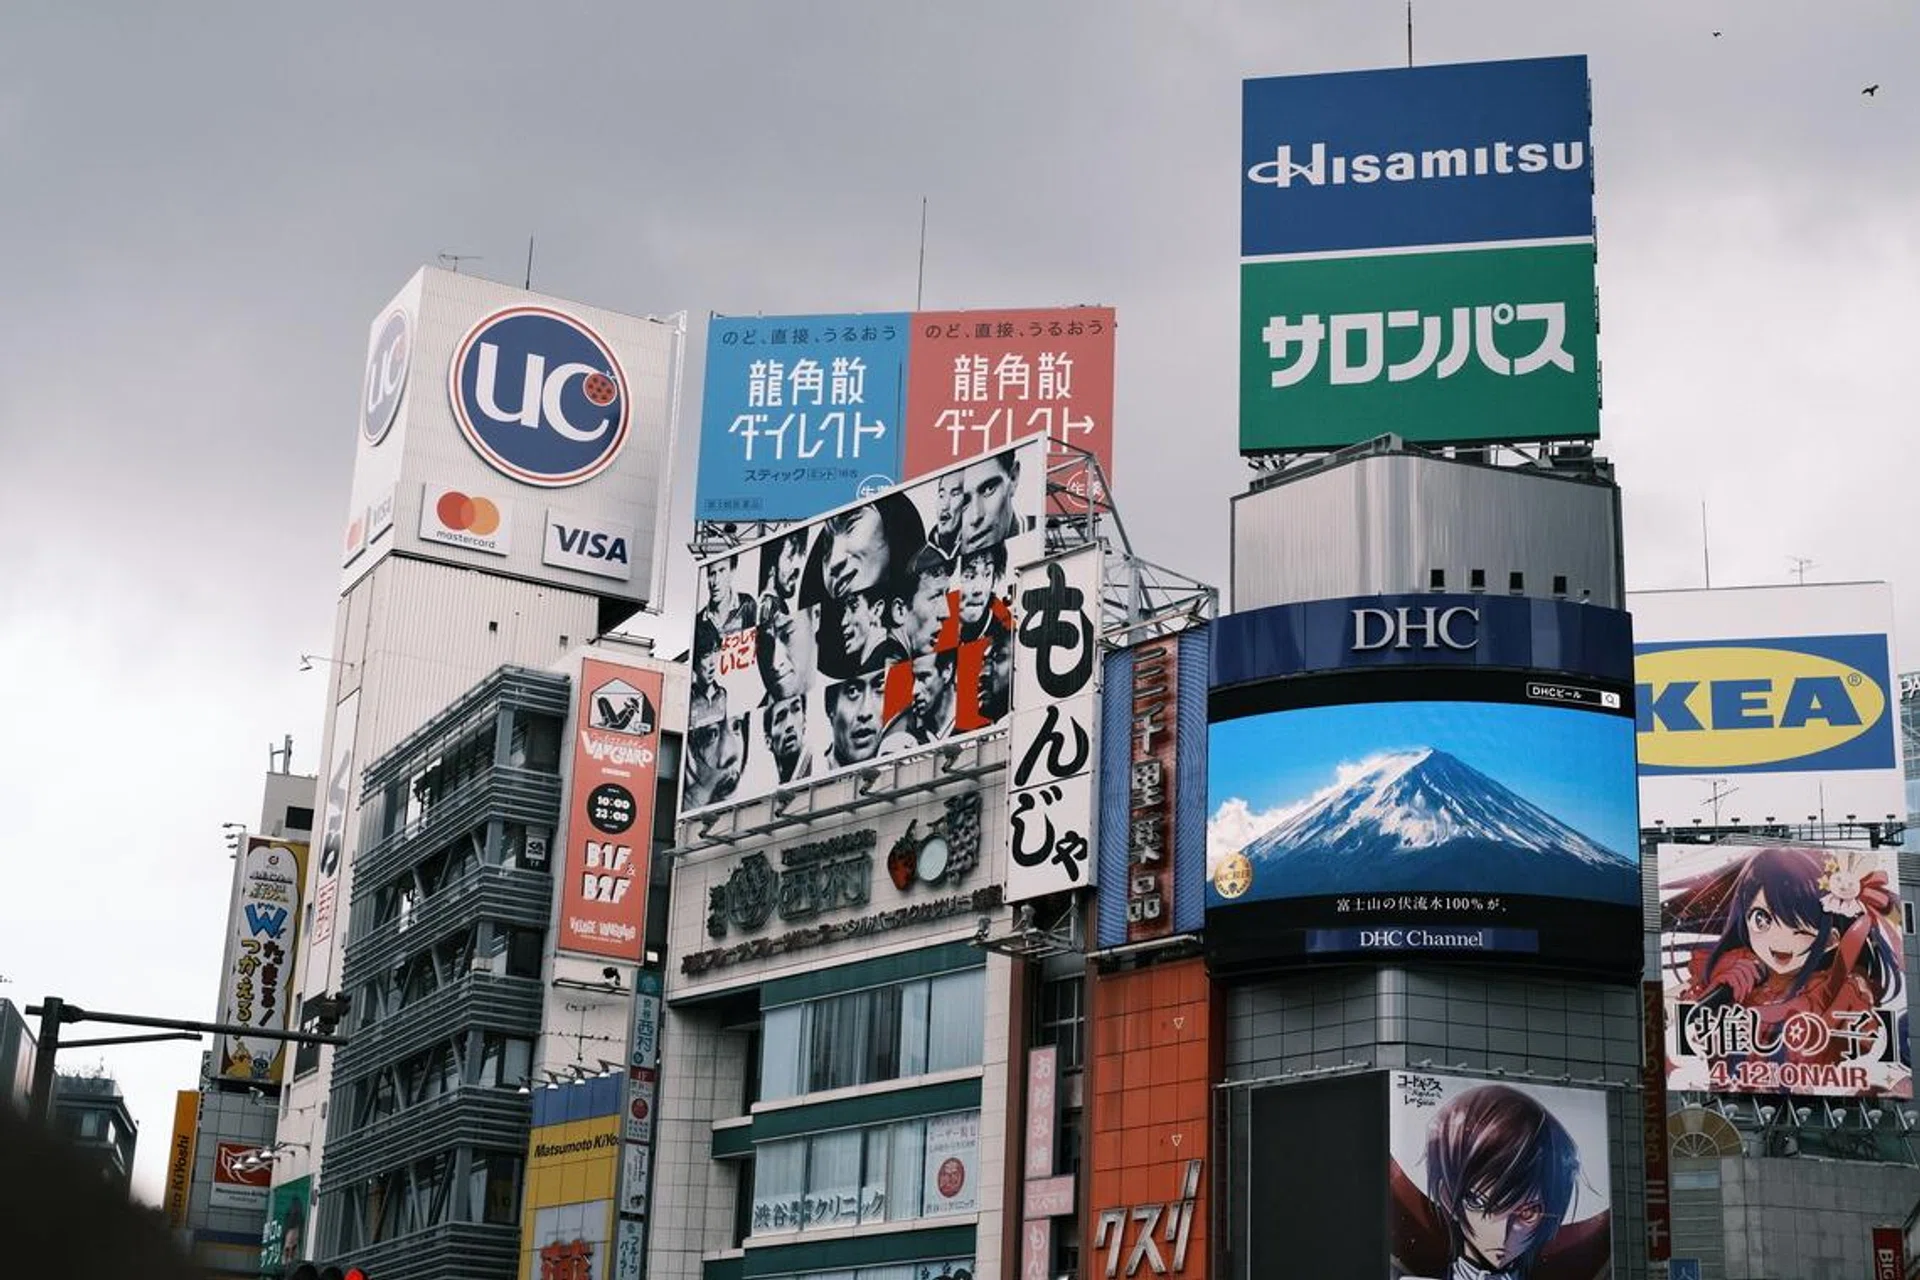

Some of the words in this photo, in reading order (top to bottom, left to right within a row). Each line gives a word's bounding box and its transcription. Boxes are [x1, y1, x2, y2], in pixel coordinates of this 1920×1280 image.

[1247, 141, 1584, 188] Hisamitsu
[722, 326, 898, 346] のど、直接、うるおう
[925, 319, 1104, 340] のど、直接、うるおう
[1262, 303, 1575, 388] サロンパス
[474, 341, 610, 442] UC
[748, 357, 868, 408] 龍角散
[953, 351, 1074, 402] 龍角散
[728, 410, 886, 461] ダイレクト
[436, 529, 496, 550] mastercard
[552, 523, 628, 565] VISA
[1351, 606, 1480, 651] DHC
[1532, 687, 1582, 699] DHCビール
[1635, 675, 1863, 733] KEA
[1009, 562, 1095, 882] もんじゃ
[597, 795, 631, 810] 10:00
[585, 840, 632, 870] B1F
[582, 872, 631, 904] B2F
[1360, 931, 1403, 947] DHC
[1406, 929, 1484, 947] Channel
[534, 1138, 592, 1158] Matsumoto
